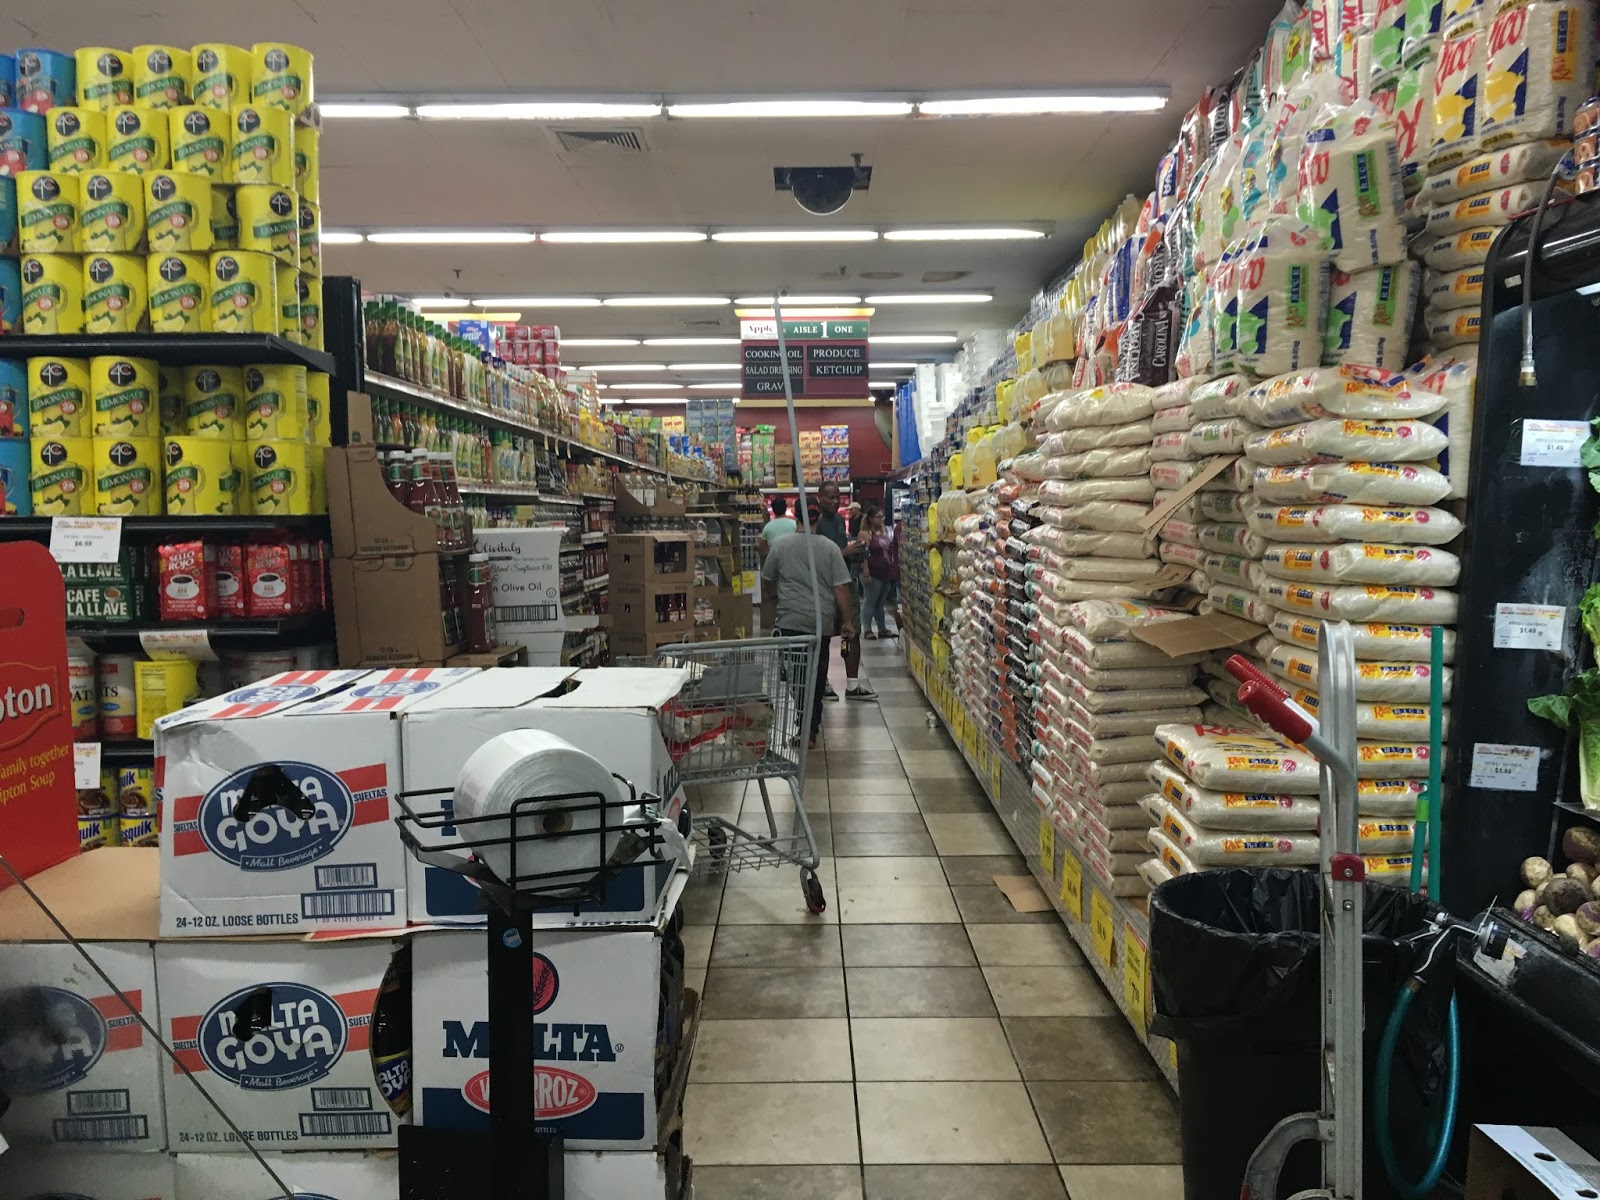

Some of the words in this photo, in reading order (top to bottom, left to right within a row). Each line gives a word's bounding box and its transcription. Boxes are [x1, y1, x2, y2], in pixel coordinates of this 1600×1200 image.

[186, 112, 206, 132] 4C
[90, 260, 109, 280] 4C
[161, 260, 181, 279] 4C
[217, 260, 234, 279] 4C
[793, 326, 818, 334] AISLE
[820, 322, 829, 338] 1
[834, 326, 853, 334] ONE
[1152, 320, 1169, 367] CAROLINA
[788, 350, 802, 358] OIL
[813, 349, 860, 358] PRODUCE
[42, 364, 62, 385] 4C
[110, 364, 132, 385] 4C
[745, 367, 769, 375] SALAD
[769, 367, 803, 375] DRESING
[816, 366, 862, 374] KETCHUP
[757, 382, 786, 391] GRAV
[34, 391, 77, 410] LEMONADE
[101, 390, 145, 410] LEMONADE
[42, 445, 62, 465] 4C
[111, 445, 132, 464] 4C
[256, 447, 272, 466] 4C
[35, 470, 77, 488] LEMONADE
[102, 470, 145, 488] LEMONADE
[473, 539, 521, 555] Olivitaly
[168, 558, 195, 571] ROJO
[169, 551, 195, 563] SELLO
[80, 563, 121, 577] LLAVE
[66, 589, 100, 602] CAFE
[501, 583, 525, 592] Olive
[528, 583, 542, 591] Oil
[66, 603, 84, 616] LA
[87, 602, 127, 615] LLAVE
[1374, 706, 1392, 718] Rico
[30, 744, 69, 767] together
[0, 781, 27, 806] ipton
[30, 771, 56, 791] Soup
[353, 788, 388, 803] SUELTAS
[174, 820, 198, 833] SUELTAS
[217, 801, 340, 852] GOYA
[1360, 825, 1376, 837] Rico
[250, 855, 275, 868] Malt
[278, 845, 319, 867] Beverage
[1367, 858, 1384, 870] Rico
[176, 917, 204, 928] 24-12
[205, 916, 220, 927] OZ.
[222, 915, 255, 926] LOOSE
[256, 913, 299, 925] BOTTLES
[218, 998, 320, 1034] MLTA
[348, 1014, 371, 1027] SUELT
[173, 1041, 197, 1051] SUELTAS
[216, 1024, 335, 1070] GOYA
[443, 1021, 616, 1062] MLTA
[249, 1076, 273, 1088] Malt
[276, 1069, 314, 1087] Beverage
[378, 1059, 409, 1085] ALTA
[179, 1131, 207, 1142] 24-12
[207, 1131, 221, 1142] OZ.
[223, 1130, 255, 1142] LOOSE
[257, 1130, 298, 1142] BOTTLES
